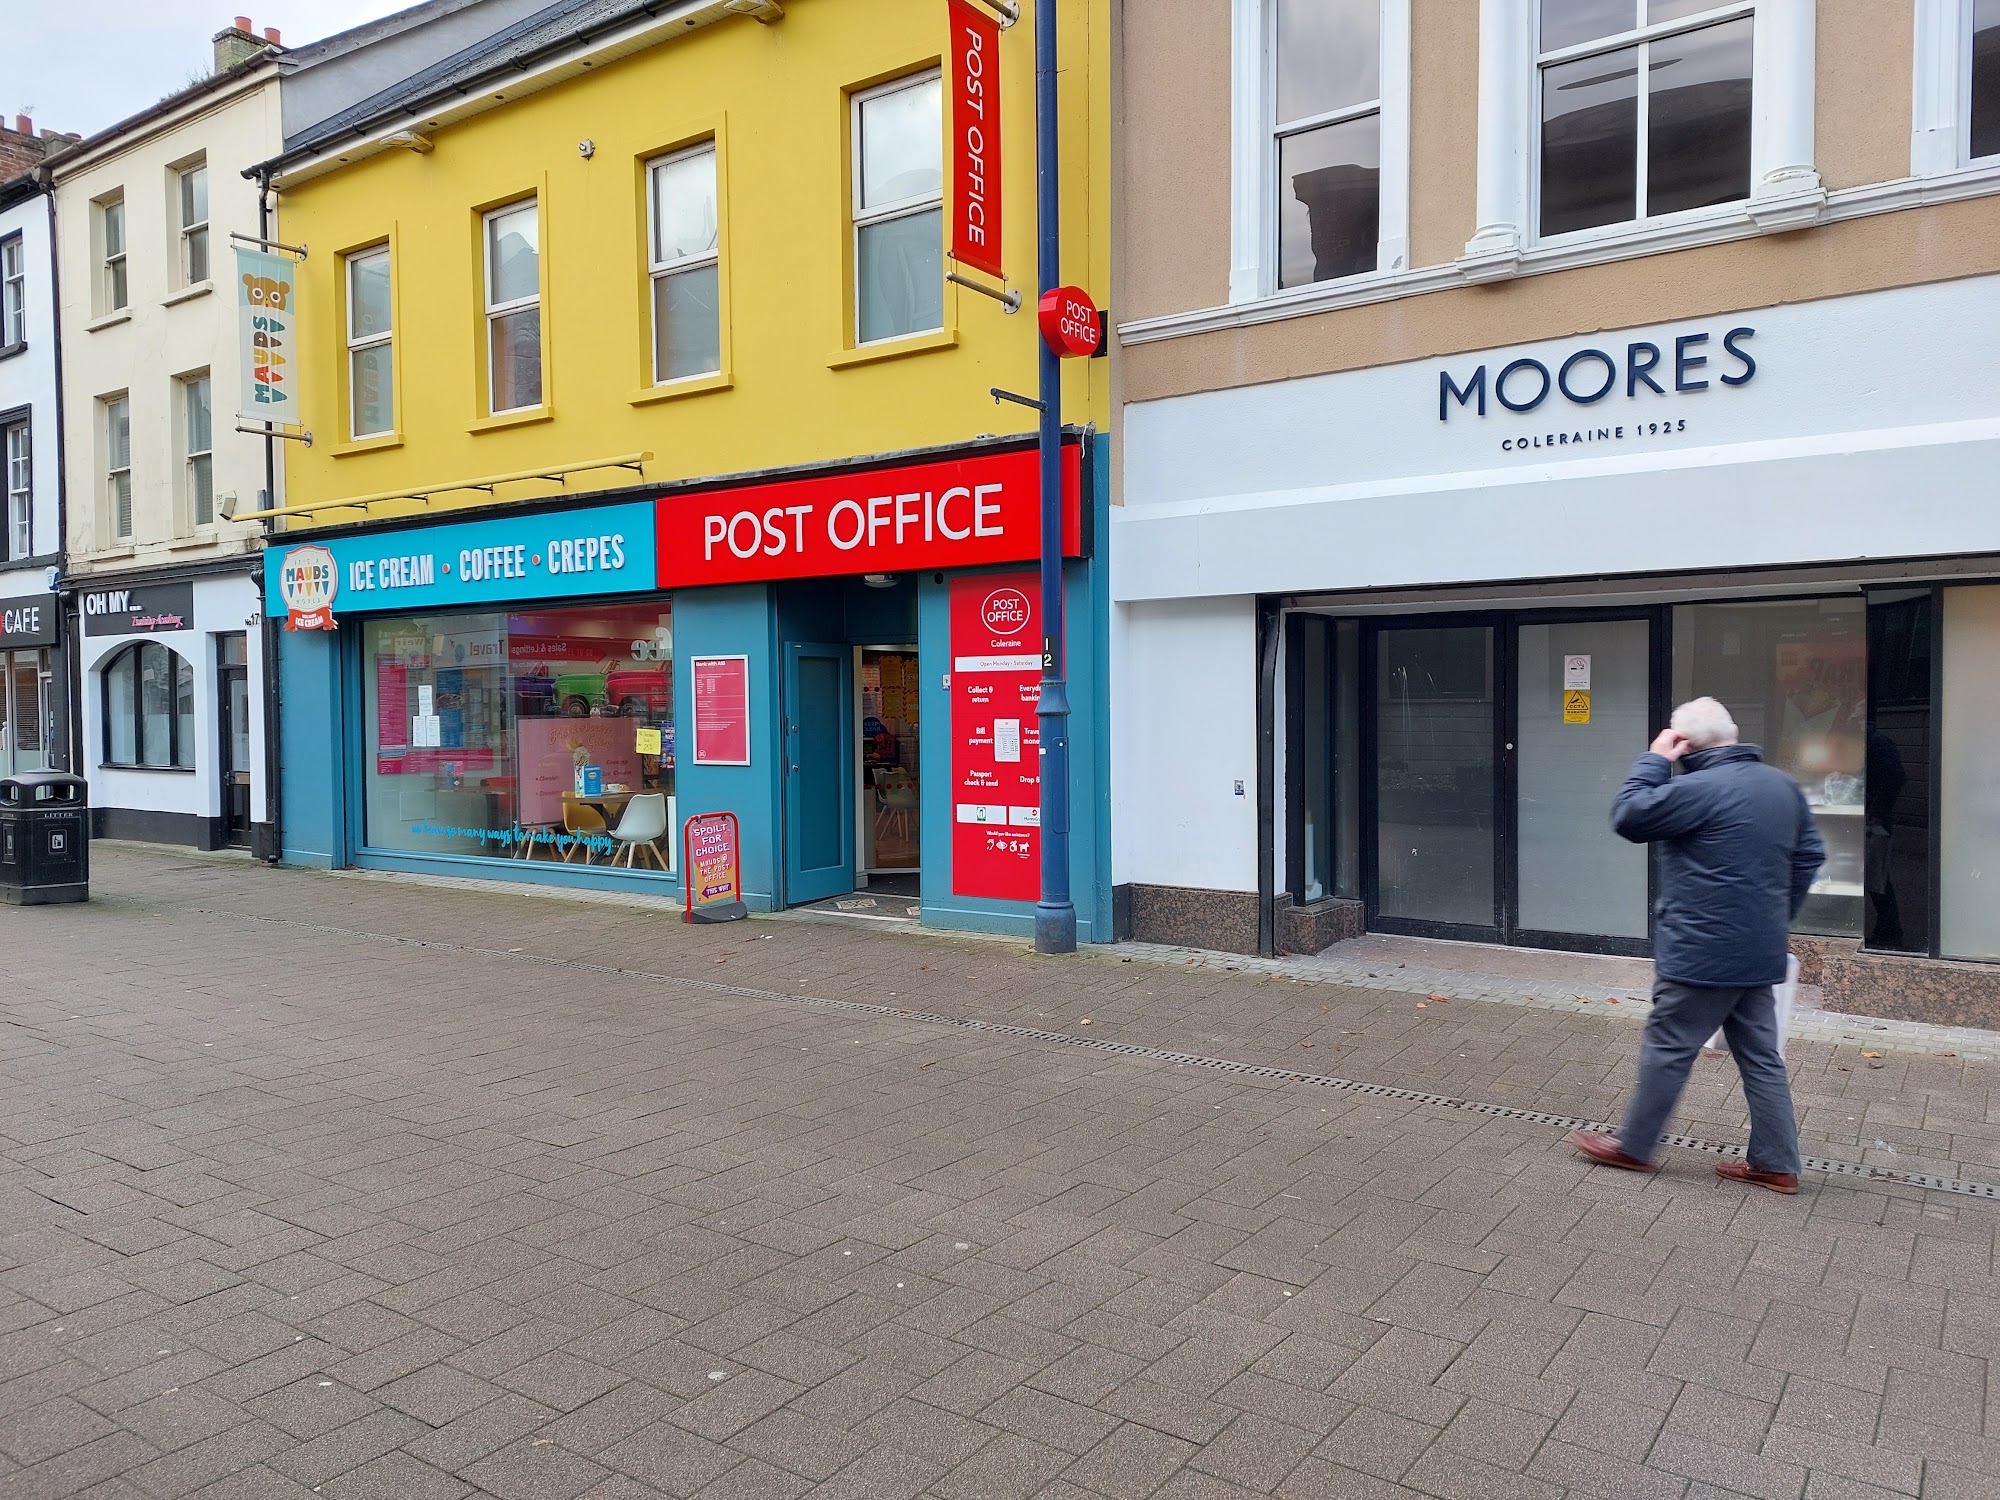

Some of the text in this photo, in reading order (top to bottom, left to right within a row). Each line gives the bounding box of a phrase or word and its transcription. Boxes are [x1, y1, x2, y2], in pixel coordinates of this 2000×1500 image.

[966, 27, 985, 246] POST OFFICE
[1066, 300, 1092, 324] POST
[1060, 317, 1096, 345] OFFICE
[253, 315, 270, 404] MAUDS
[1439, 327, 1757, 421] MOORES
[1501, 419, 1687, 451] COLERAINE 1925
[704, 482, 1004, 561] POST OFFICE
[349, 534, 625, 591] ICE CREAM COFFEE CREPES
[286, 565, 329, 582] MAUDS
[86, 594, 105, 615] OH
[993, 598, 1019, 610] POST
[5, 607, 40, 633] CAFE
[295, 617, 304, 626] ICE
[304, 615, 324, 627] CREAM
[987, 610, 1024, 622] OFFICE
[990, 639, 1022, 648] Coleraine
[1021, 693, 1040, 701] bankin
[1024, 727, 1040, 735] Trave
[970, 770, 992, 778] Passport
[1020, 776, 1034, 784] Drop
[693, 824, 727, 836] SPOILT
[458, 827, 485, 846] many
[487, 829, 510, 847] ways
[513, 824, 525, 841] to
[527, 826, 555, 844] make
[557, 833, 576, 852] you
[702, 834, 722, 845] FOR
[696, 843, 729, 857] CHOICE
[721, 853, 728, 862] @
[700, 864, 729, 875] THE POST
[704, 872, 727, 882] OFFICE
[706, 884, 730, 895] THIS WAY
